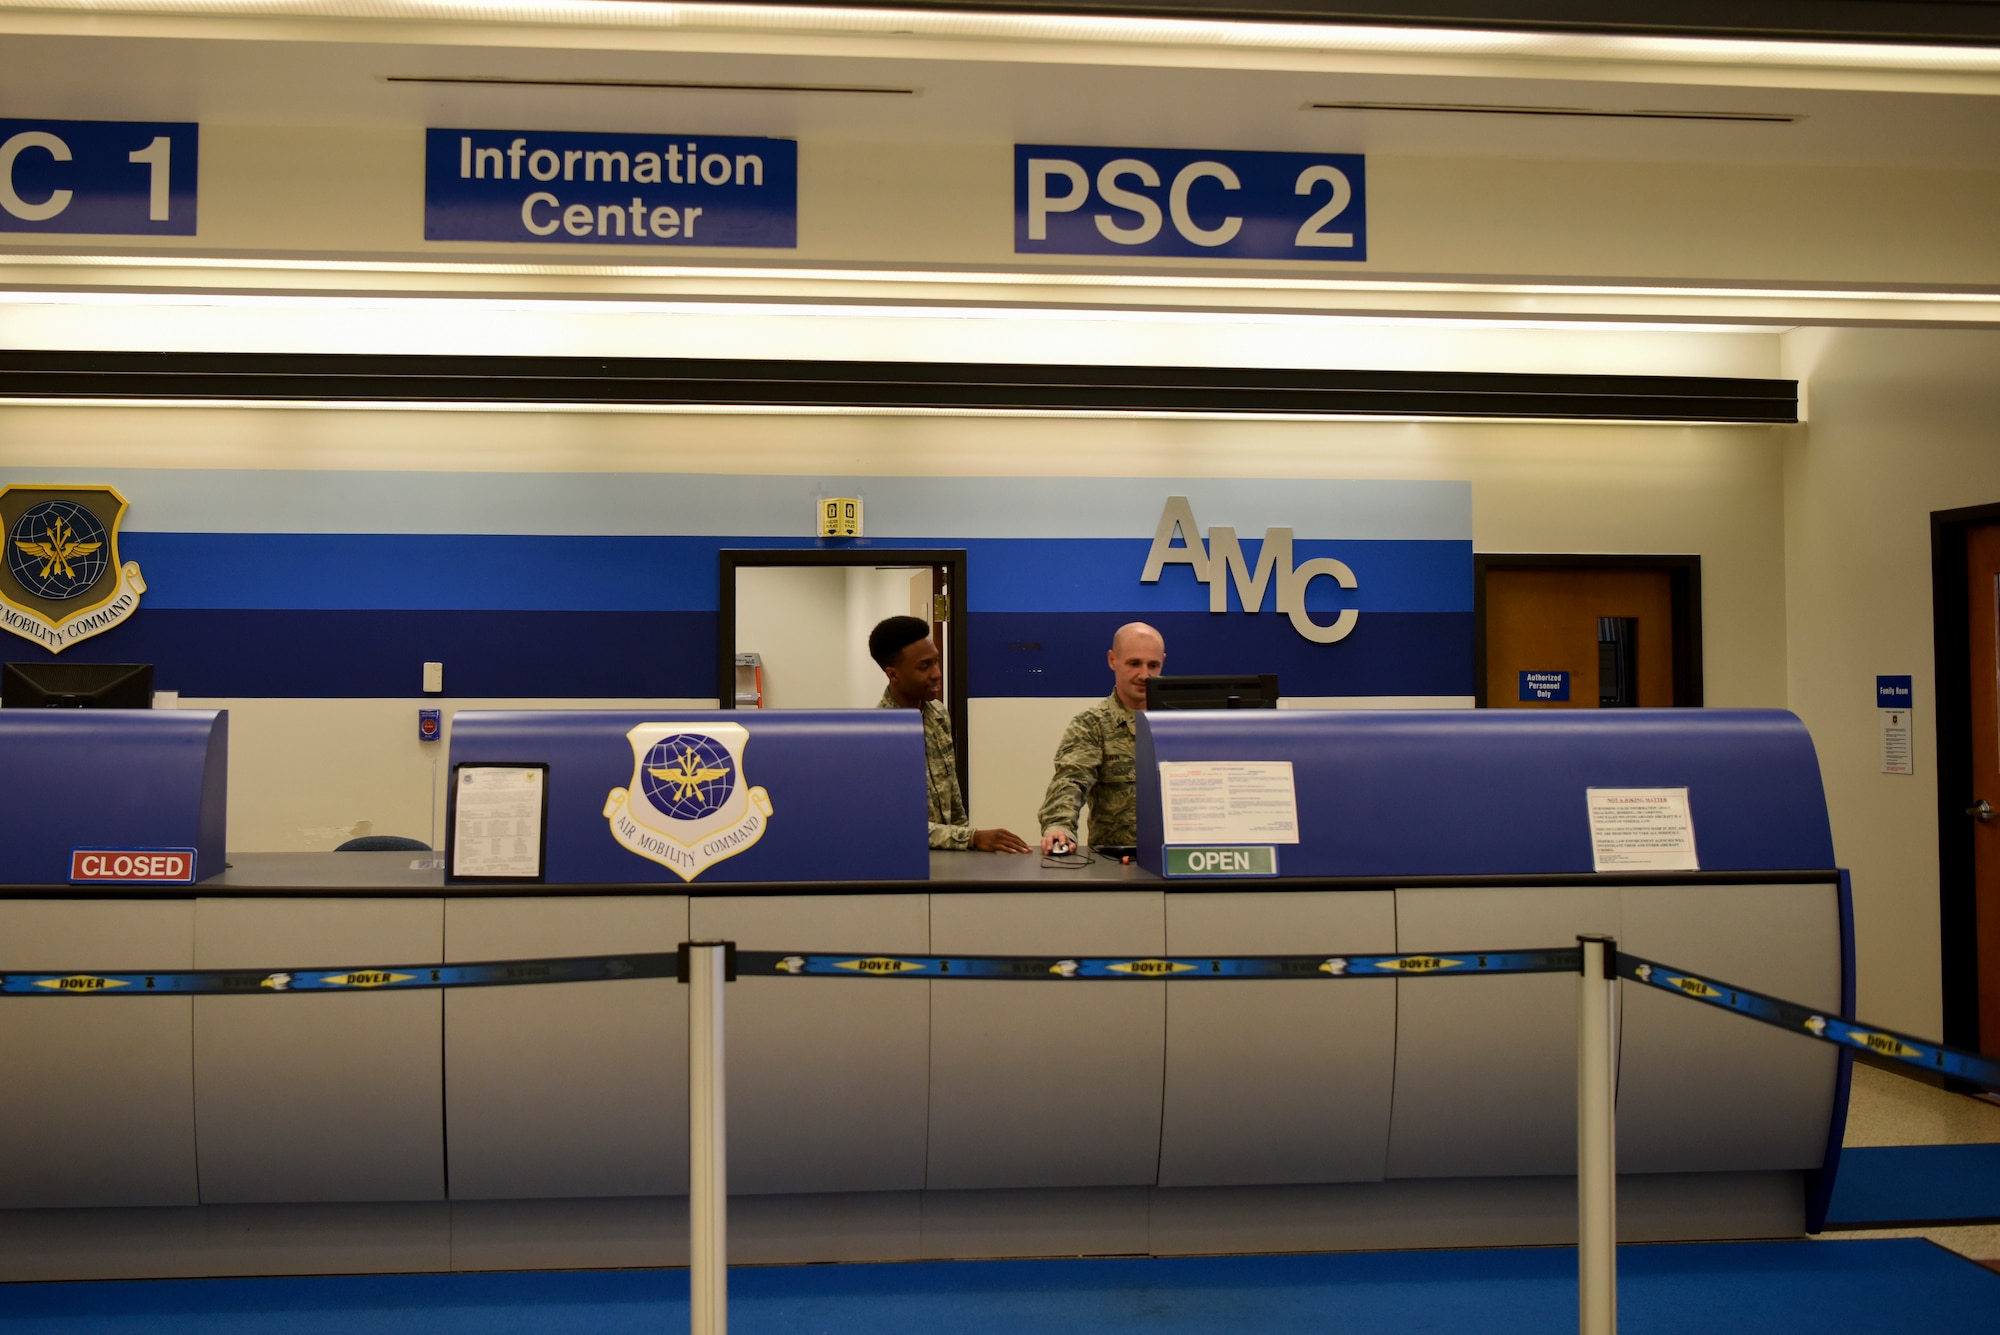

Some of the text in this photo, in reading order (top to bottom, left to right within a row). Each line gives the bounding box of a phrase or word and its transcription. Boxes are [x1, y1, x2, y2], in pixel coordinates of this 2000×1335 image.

[460, 137, 764, 186] Information
[129, 136, 171, 221] 1
[1028, 158, 1354, 248] PSC 2
[521, 191, 703, 238] Center
[1140, 496, 1359, 644] AMC
[2, 594, 133, 646] MOBILITY COMMAND
[1537, 690, 1552, 698] Only
[1880, 686, 1908, 696] Family Room
[617, 815, 759, 867] AIR MOBILITY COMMAND
[81, 855, 184, 877] CLOSED
[1188, 851, 1250, 871] OPEN
[859, 960, 902, 971] DOVER
[1131, 962, 1174, 972] DOVER
[1398, 959, 1441, 969] DOVER
[59, 978, 106, 989] DOVER
[346, 973, 392, 984] DOVER
[1680, 979, 1708, 995] DOVER
[1866, 1034, 1903, 1055] DOVER
